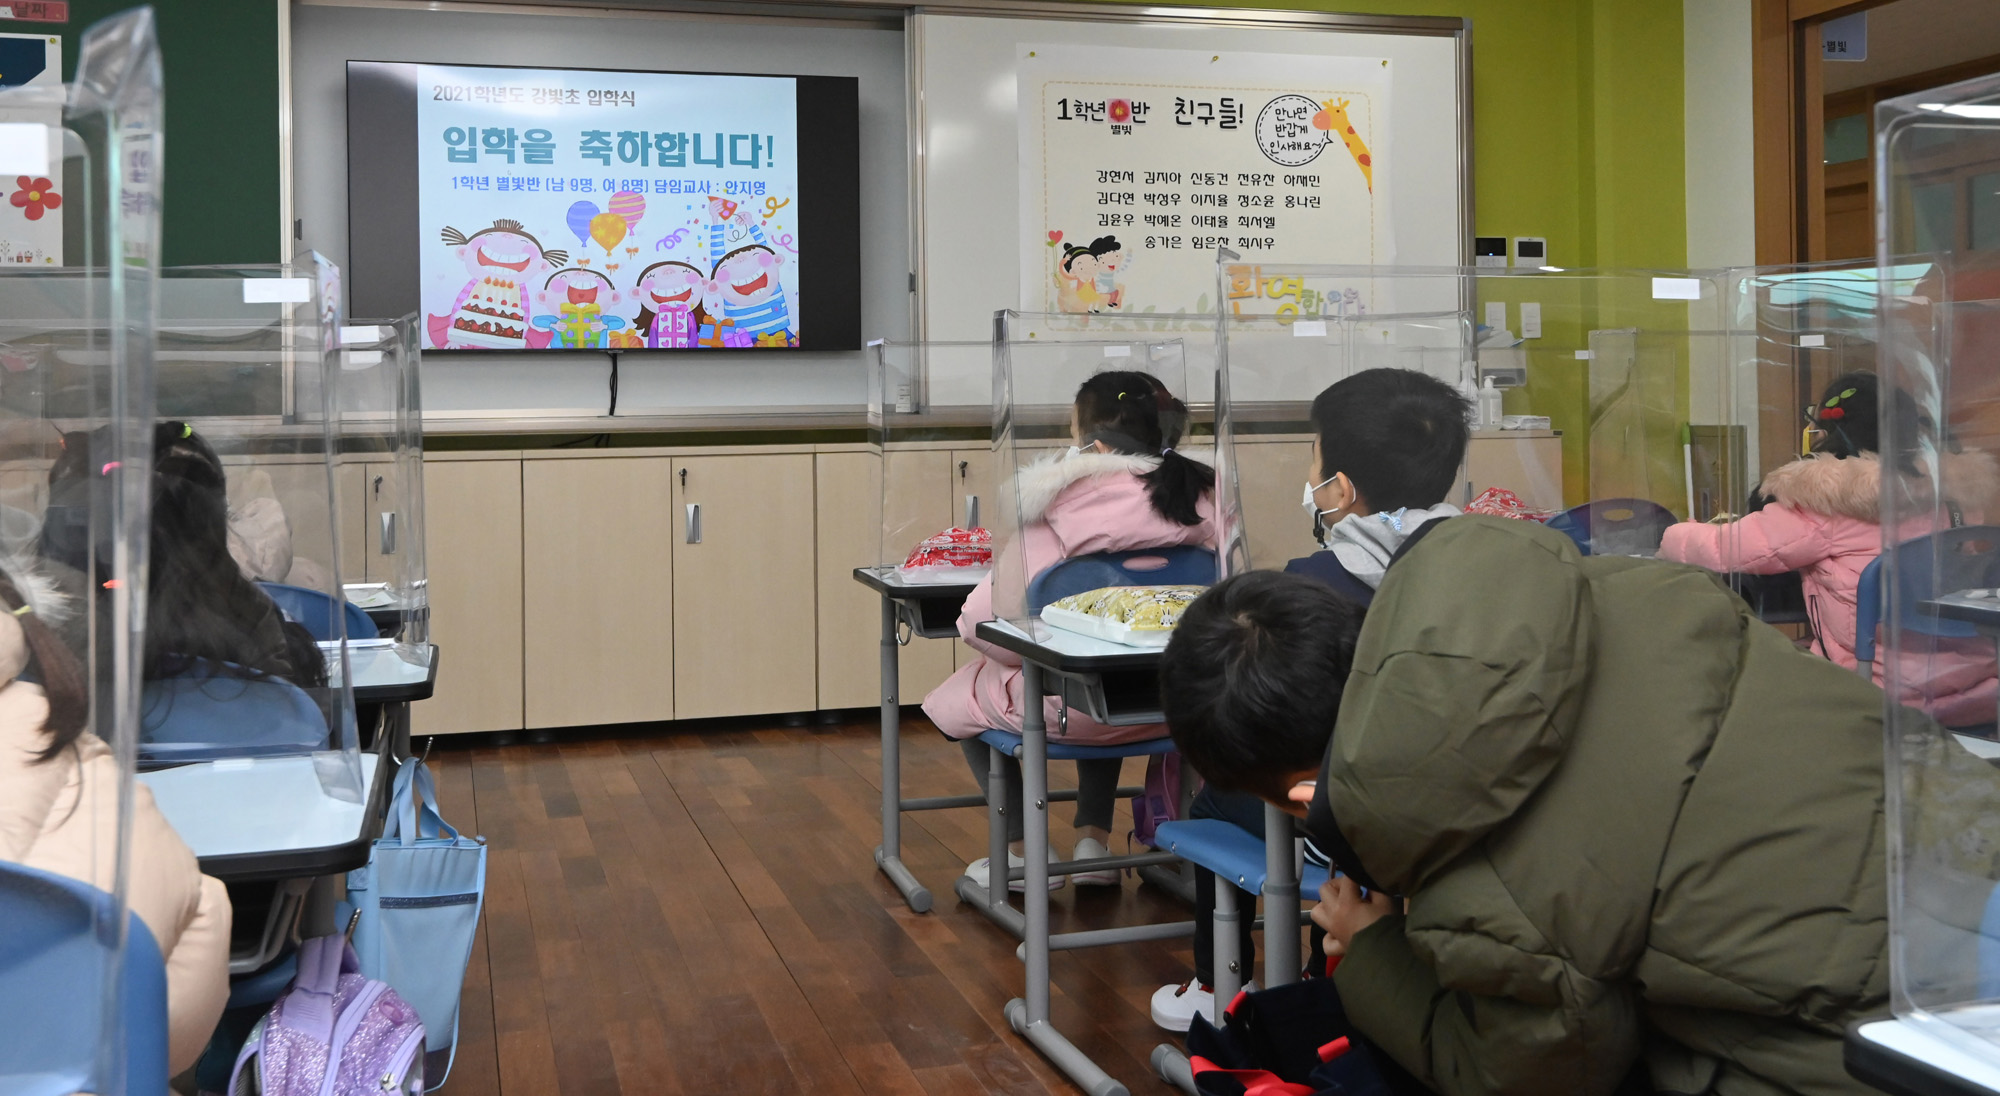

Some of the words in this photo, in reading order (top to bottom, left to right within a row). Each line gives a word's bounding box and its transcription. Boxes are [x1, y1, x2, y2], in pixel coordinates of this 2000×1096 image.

[433, 84, 524, 104] 2021학년도
[586, 89, 636, 107] 입학식
[1174, 96, 1243, 129] 친구들!
[1275, 106, 1307, 121] 만나면
[1275, 122, 1308, 138] 반갑게
[443, 126, 556, 165] 입학을
[579, 129, 774, 169] 축하합니다!
[451, 175, 490, 191] 1학년
[496, 176, 541, 192] 별빛반
[569, 177, 598, 193] 9명,
[602, 178, 616, 193] 여
[654, 179, 711, 194] 담임교사
[724, 180, 766, 196] 안지영
[1144, 171, 1181, 184] 김지아
[1191, 172, 1228, 186] 신동건
[1096, 191, 1134, 205] 김다연
[1144, 193, 1181, 206] 박성우
[1191, 194, 1228, 207] 이지율
[1237, 194, 1275, 208] 정소윤
[1284, 194, 1321, 208] 홍나린
[1096, 213, 1135, 227] 김윤우
[1144, 214, 1182, 227] 박예온
[1191, 215, 1229, 228] 이태율
[1237, 216, 1275, 229] 최서엘
[1144, 235, 1182, 249] 송가은
[1191, 236, 1230, 249] 임은찬
[1238, 236, 1275, 250] 최시우
